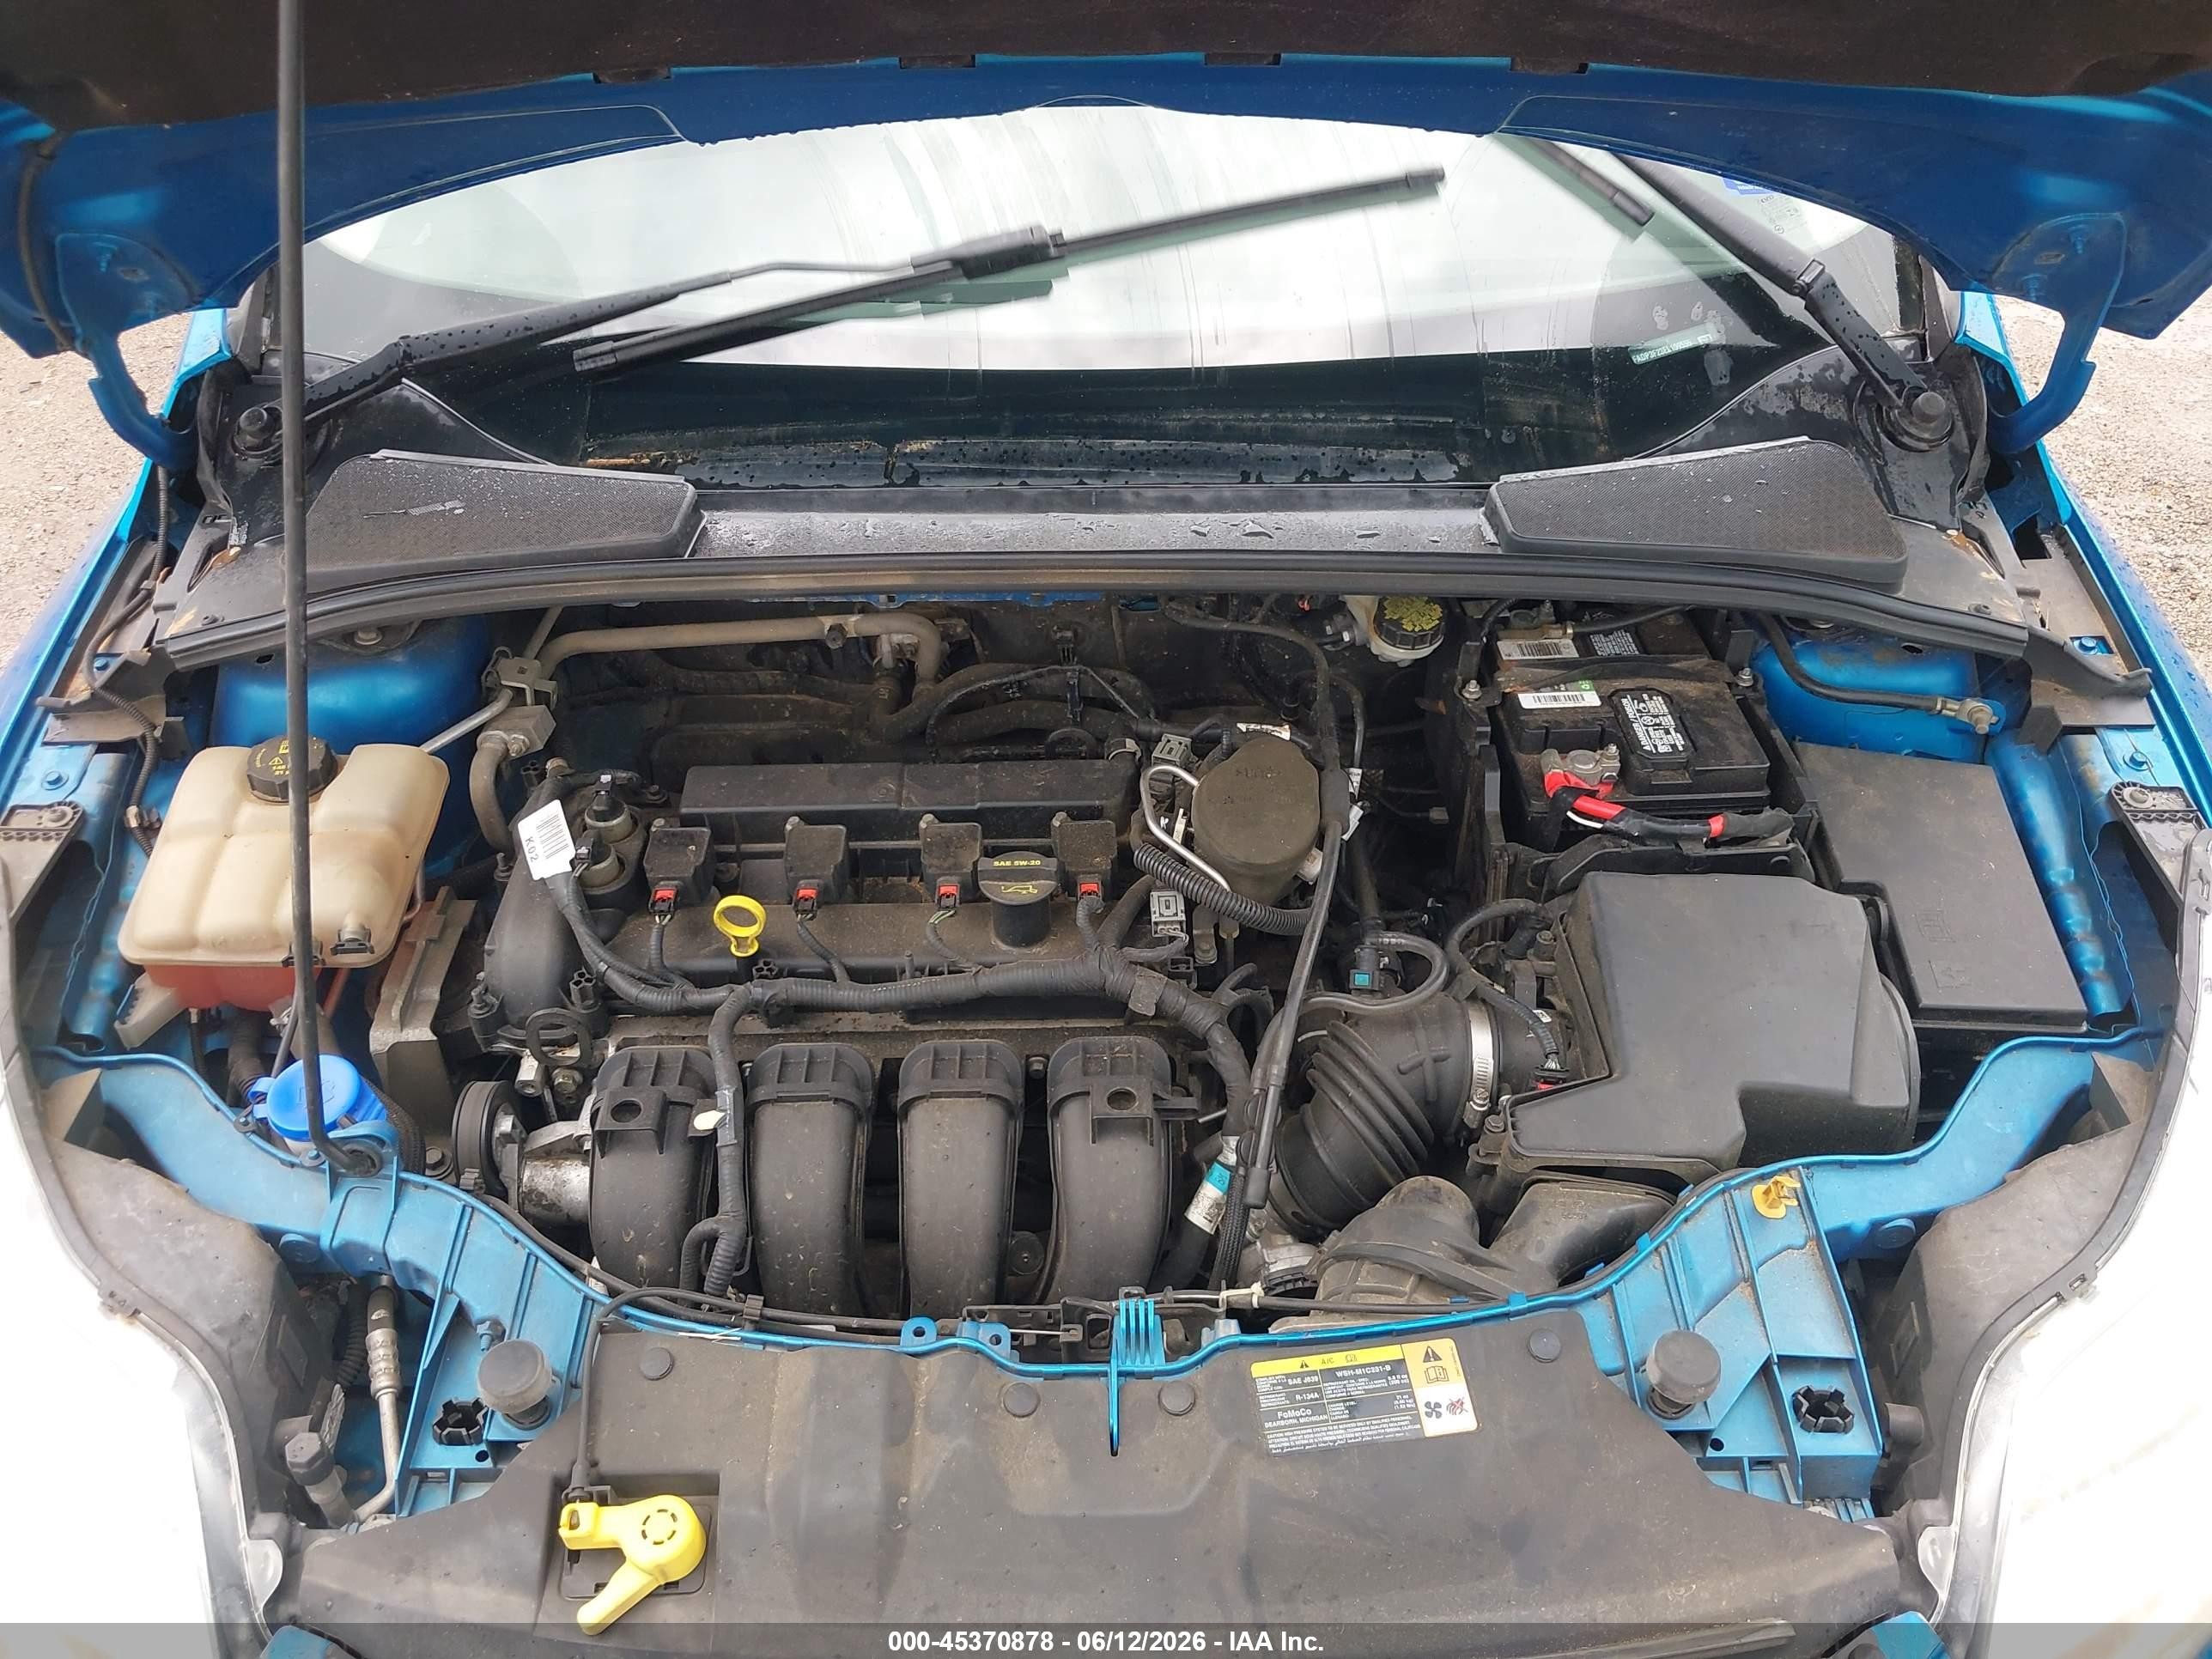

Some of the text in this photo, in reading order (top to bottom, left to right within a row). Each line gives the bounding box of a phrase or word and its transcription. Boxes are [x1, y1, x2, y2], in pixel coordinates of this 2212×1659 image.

[525, 836, 539, 863] K02
[1277, 1408, 1312, 1419] FoMoCo
[1264, 1414, 1328, 1428] DEARBORN, MICHIGAN
